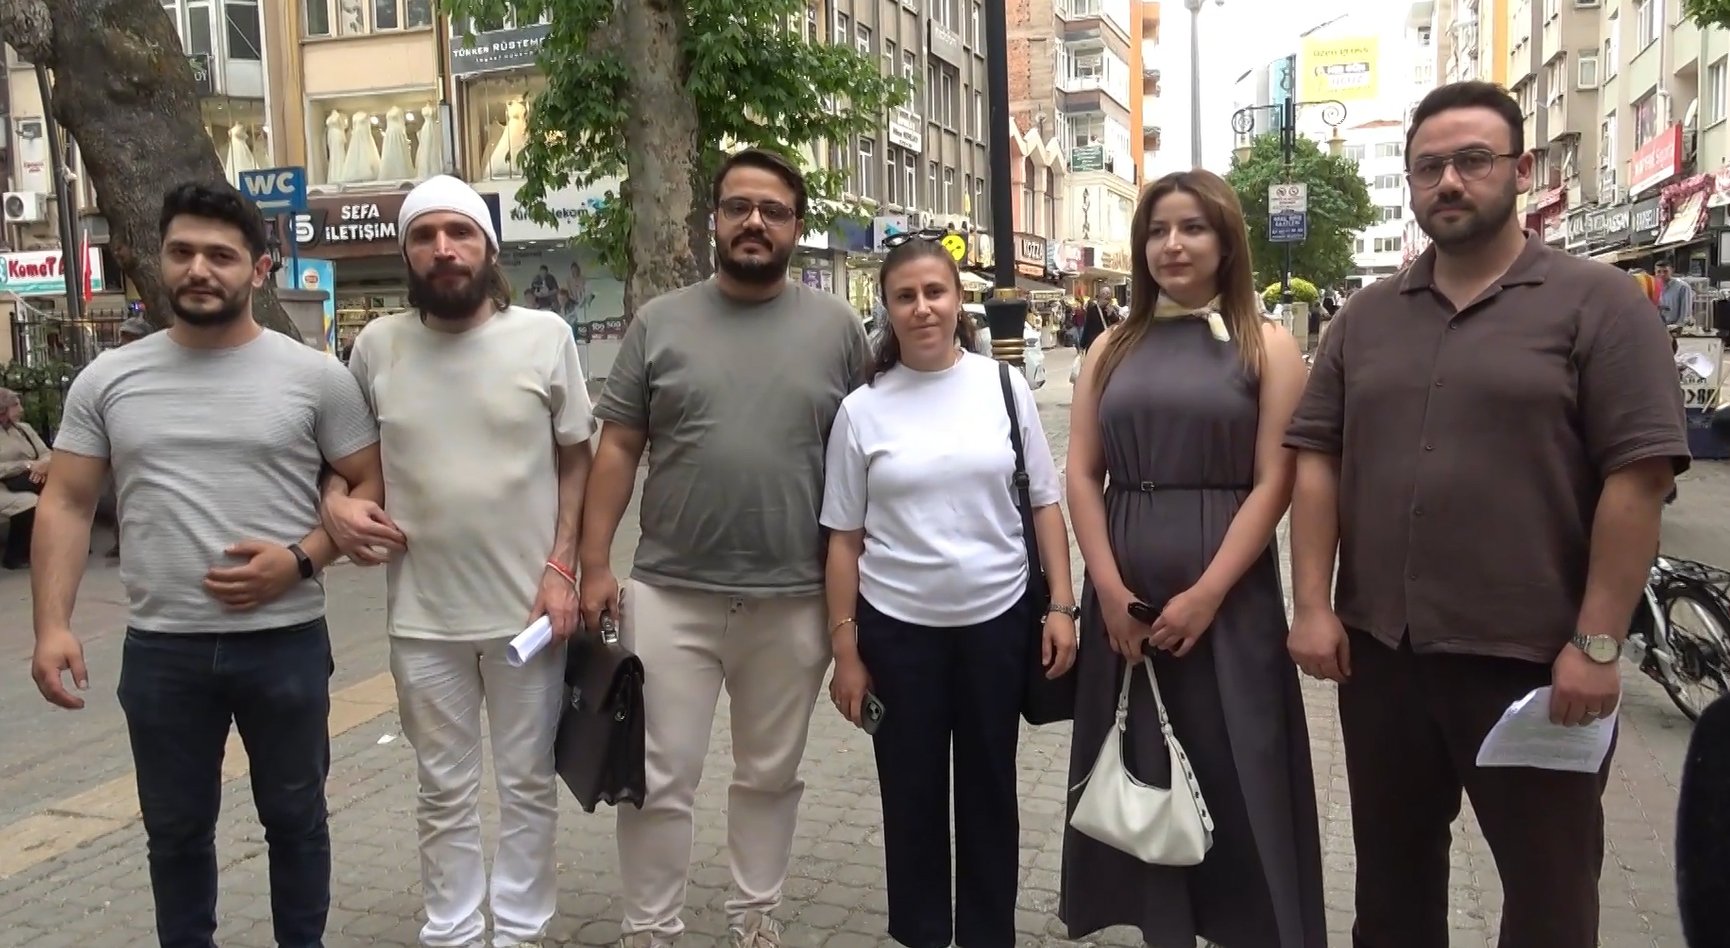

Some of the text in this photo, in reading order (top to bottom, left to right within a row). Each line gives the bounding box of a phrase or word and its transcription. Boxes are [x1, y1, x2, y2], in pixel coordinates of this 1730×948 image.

[245, 172, 296, 195] WC
[341, 204, 379, 220] SEFA
[325, 223, 396, 242] İLETİŞİM
